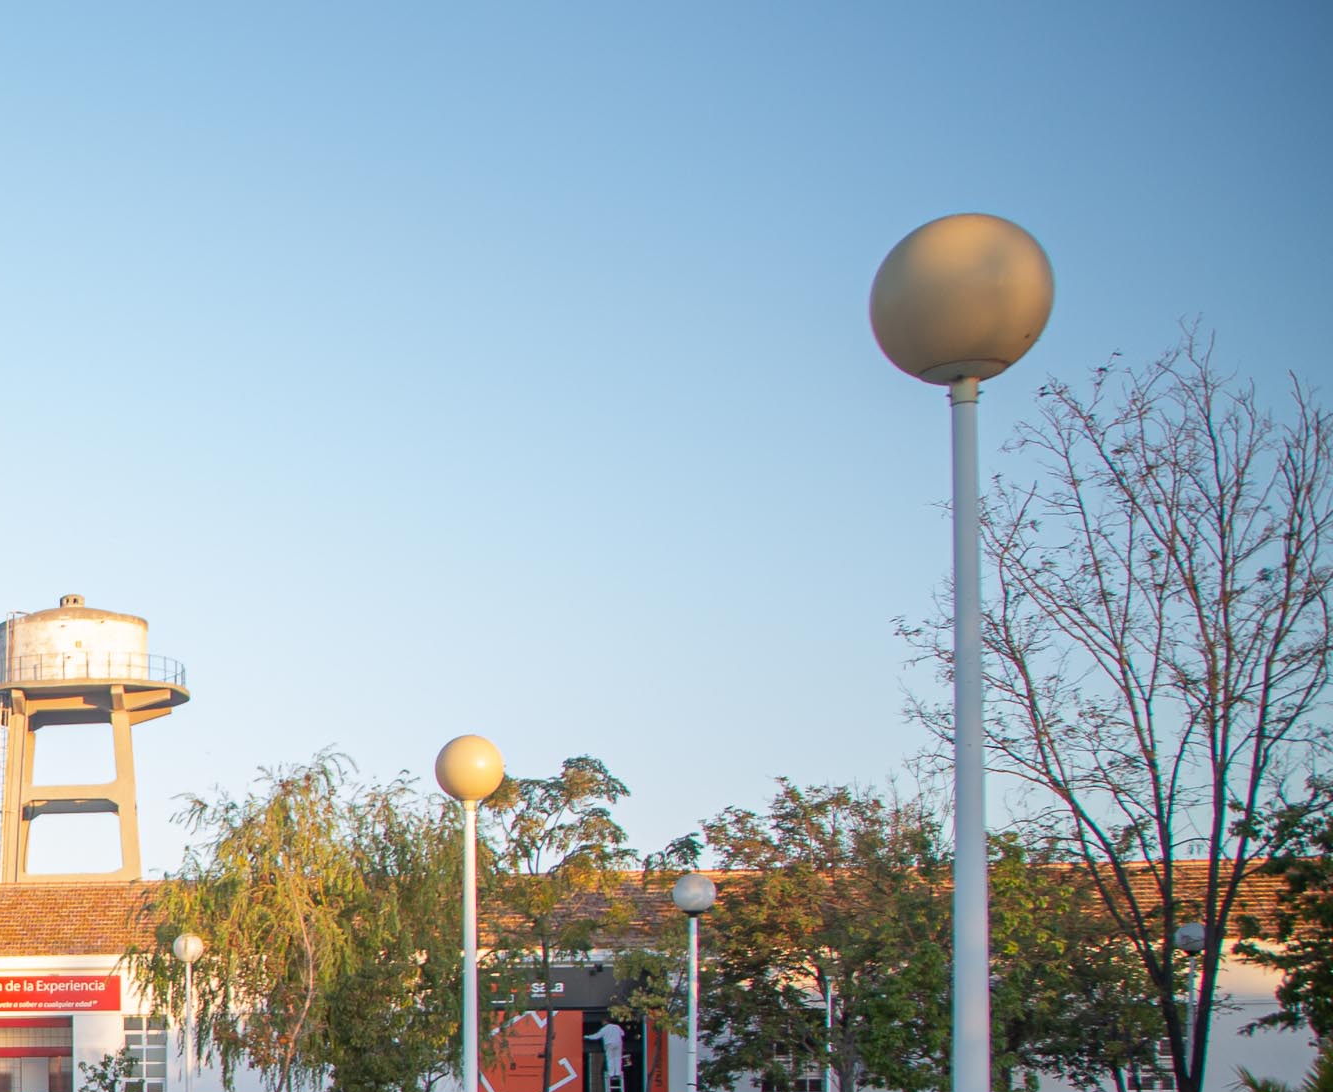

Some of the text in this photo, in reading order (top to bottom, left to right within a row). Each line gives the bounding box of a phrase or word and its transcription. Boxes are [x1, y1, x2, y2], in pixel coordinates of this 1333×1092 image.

[5, 980, 21, 992] de
[23, 980, 34, 992] la
[36, 980, 105, 994] Experiencia
[44, 1001, 75, 1009] cualquier
